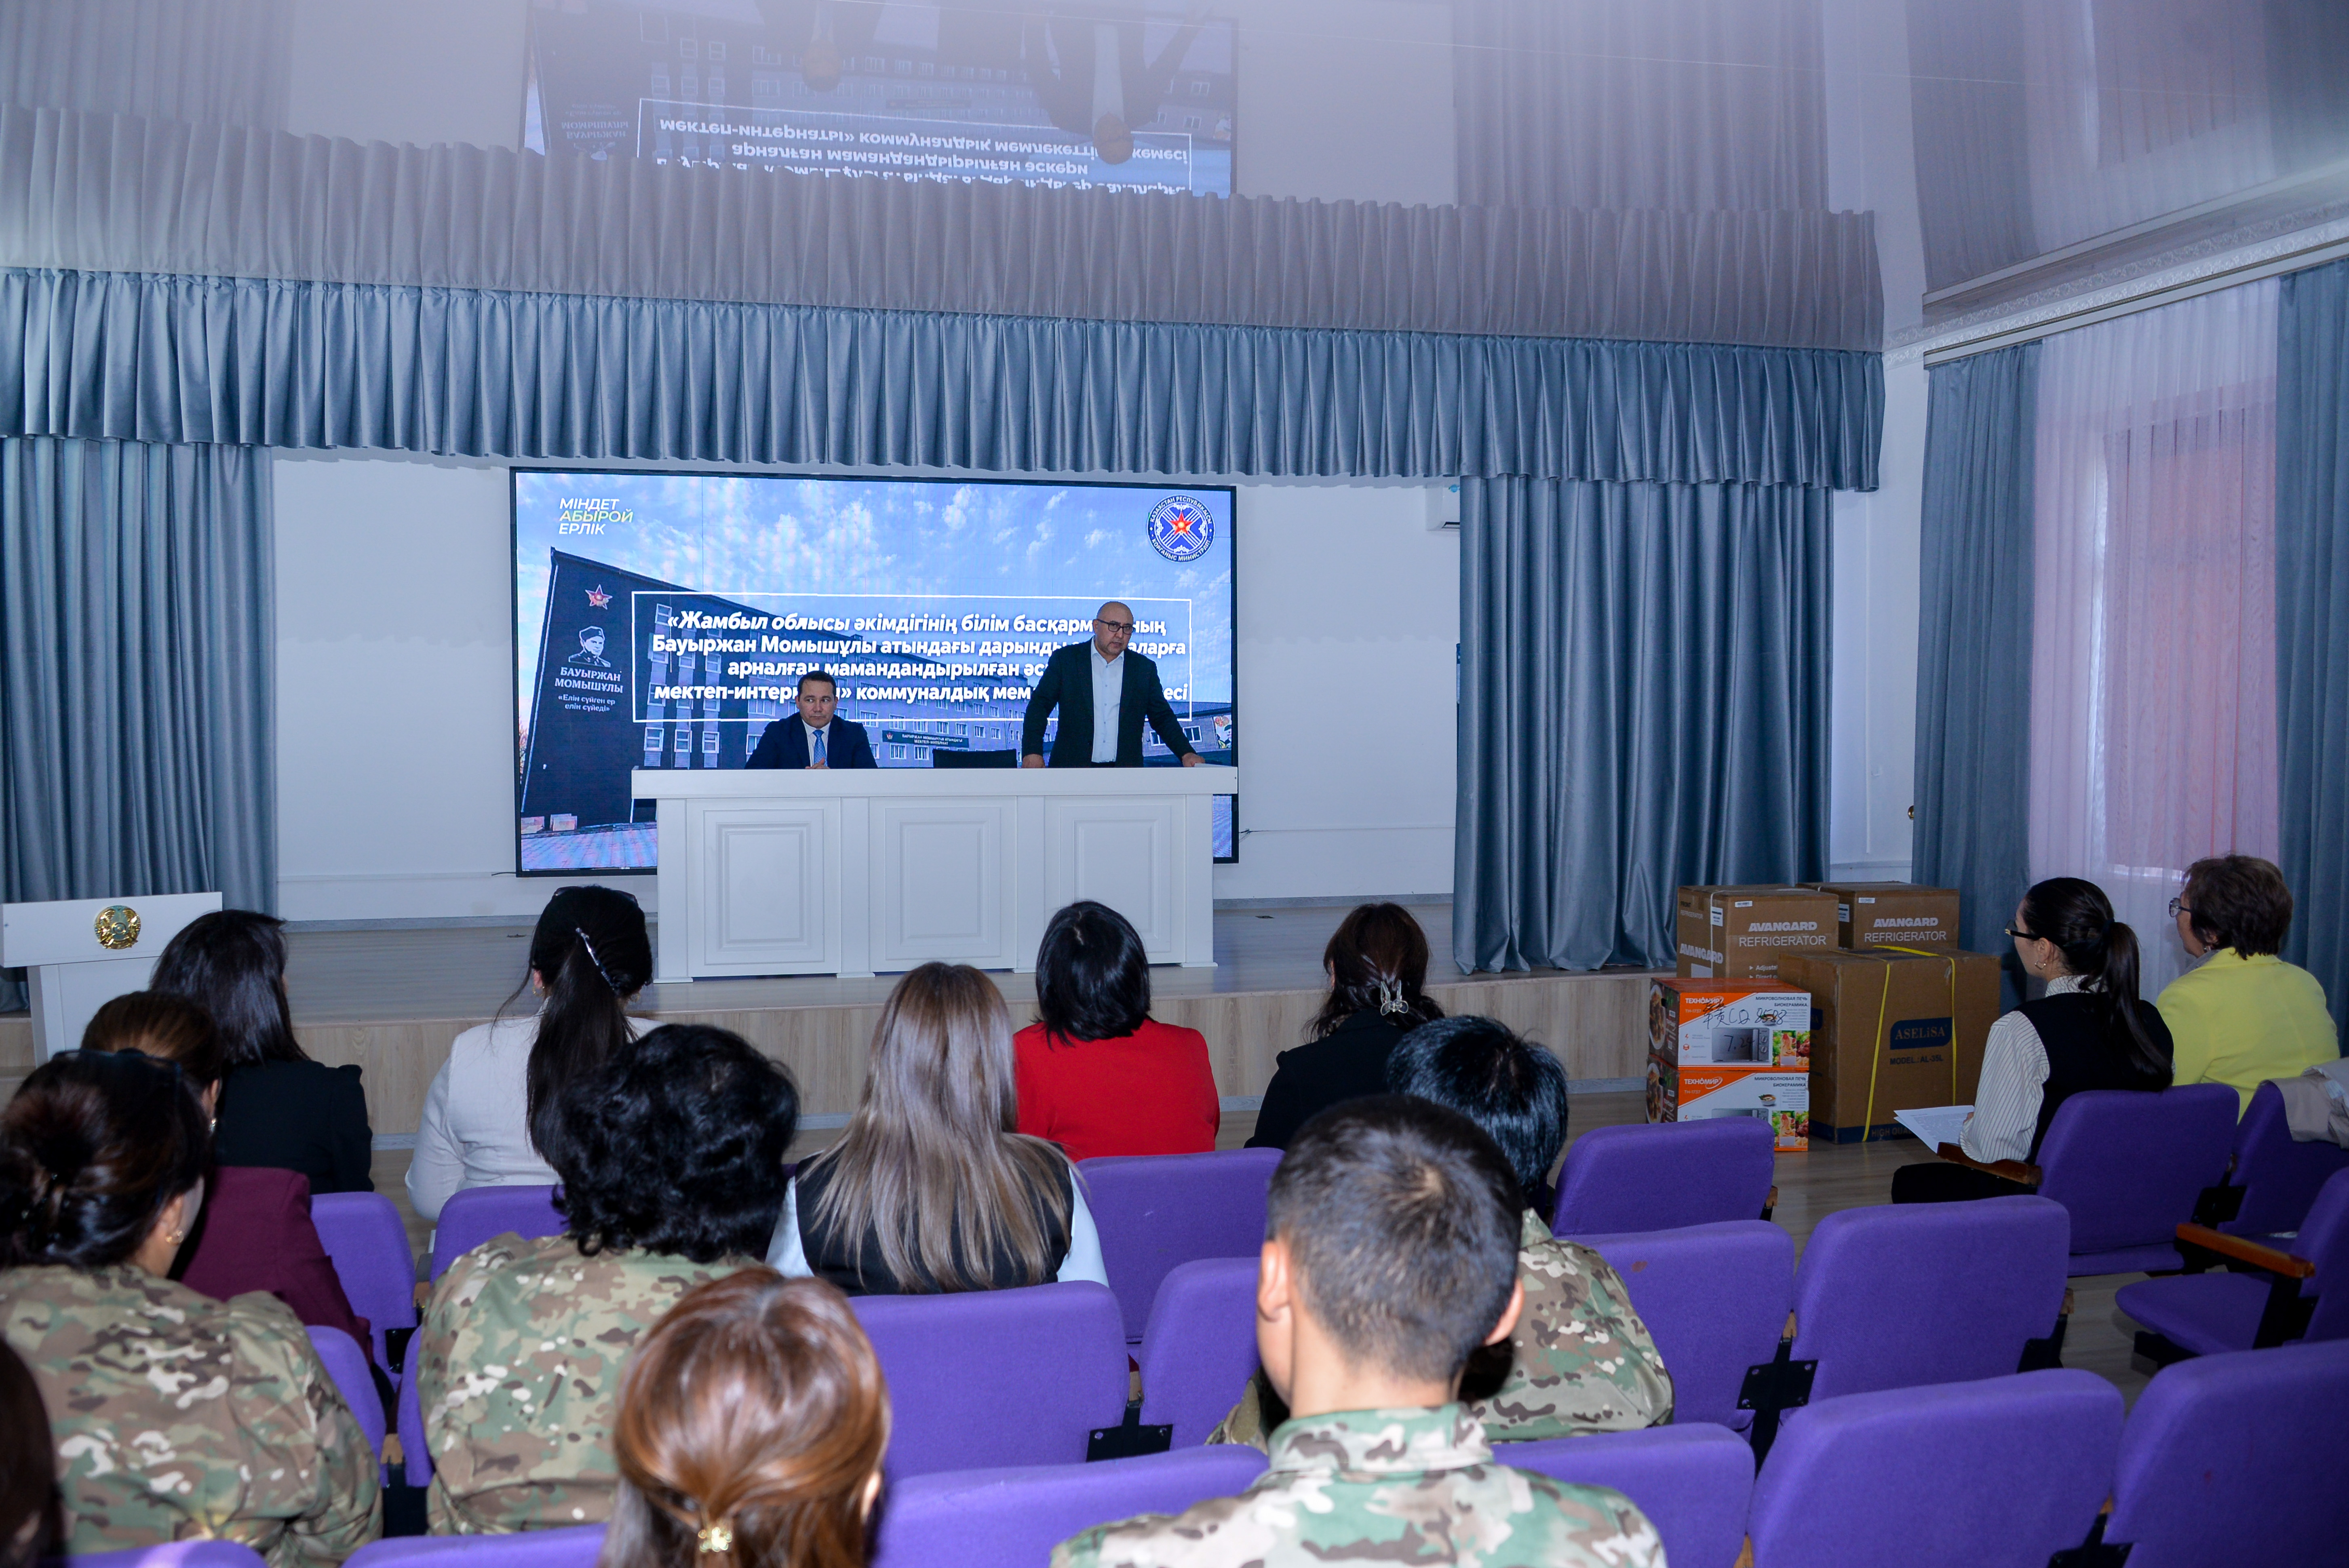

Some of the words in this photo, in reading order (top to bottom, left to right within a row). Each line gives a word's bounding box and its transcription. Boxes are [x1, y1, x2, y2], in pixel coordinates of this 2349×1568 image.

[559, 498, 620, 512] МІНДЕТ
[559, 508, 633, 523] АБЫРОЙ
[559, 523, 606, 535] ЕРЛІК
[667, 611, 767, 630] «Жамбыл
[772, 613, 850, 631] облысы
[854, 613, 957, 634] әкімдігінің
[961, 613, 1009, 632] білім
[1013, 614, 1167, 636] басқармның
[652, 634, 757, 656] Бауыржан
[761, 635, 877, 657] Момышұлы
[880, 641, 975, 656] атындағы
[560, 666, 621, 681] БАУЫРЖАН
[728, 662, 820, 679] арналған
[824, 663, 1019, 680] мамандандырылған
[555, 678, 623, 693] МОМЫШҰЛЫ
[856, 687, 989, 704] коммуналдық
[1748, 921, 1818, 932] AVANGARD
[1873, 918, 1938, 927] AVANGARD
[1739, 935, 1826, 947] REFRIGERATOR
[1864, 931, 1946, 942] REFRIGERATOR
[1679, 943, 1723, 964] AVANGARD
[1871, 1128, 1890, 1137] HIGH
